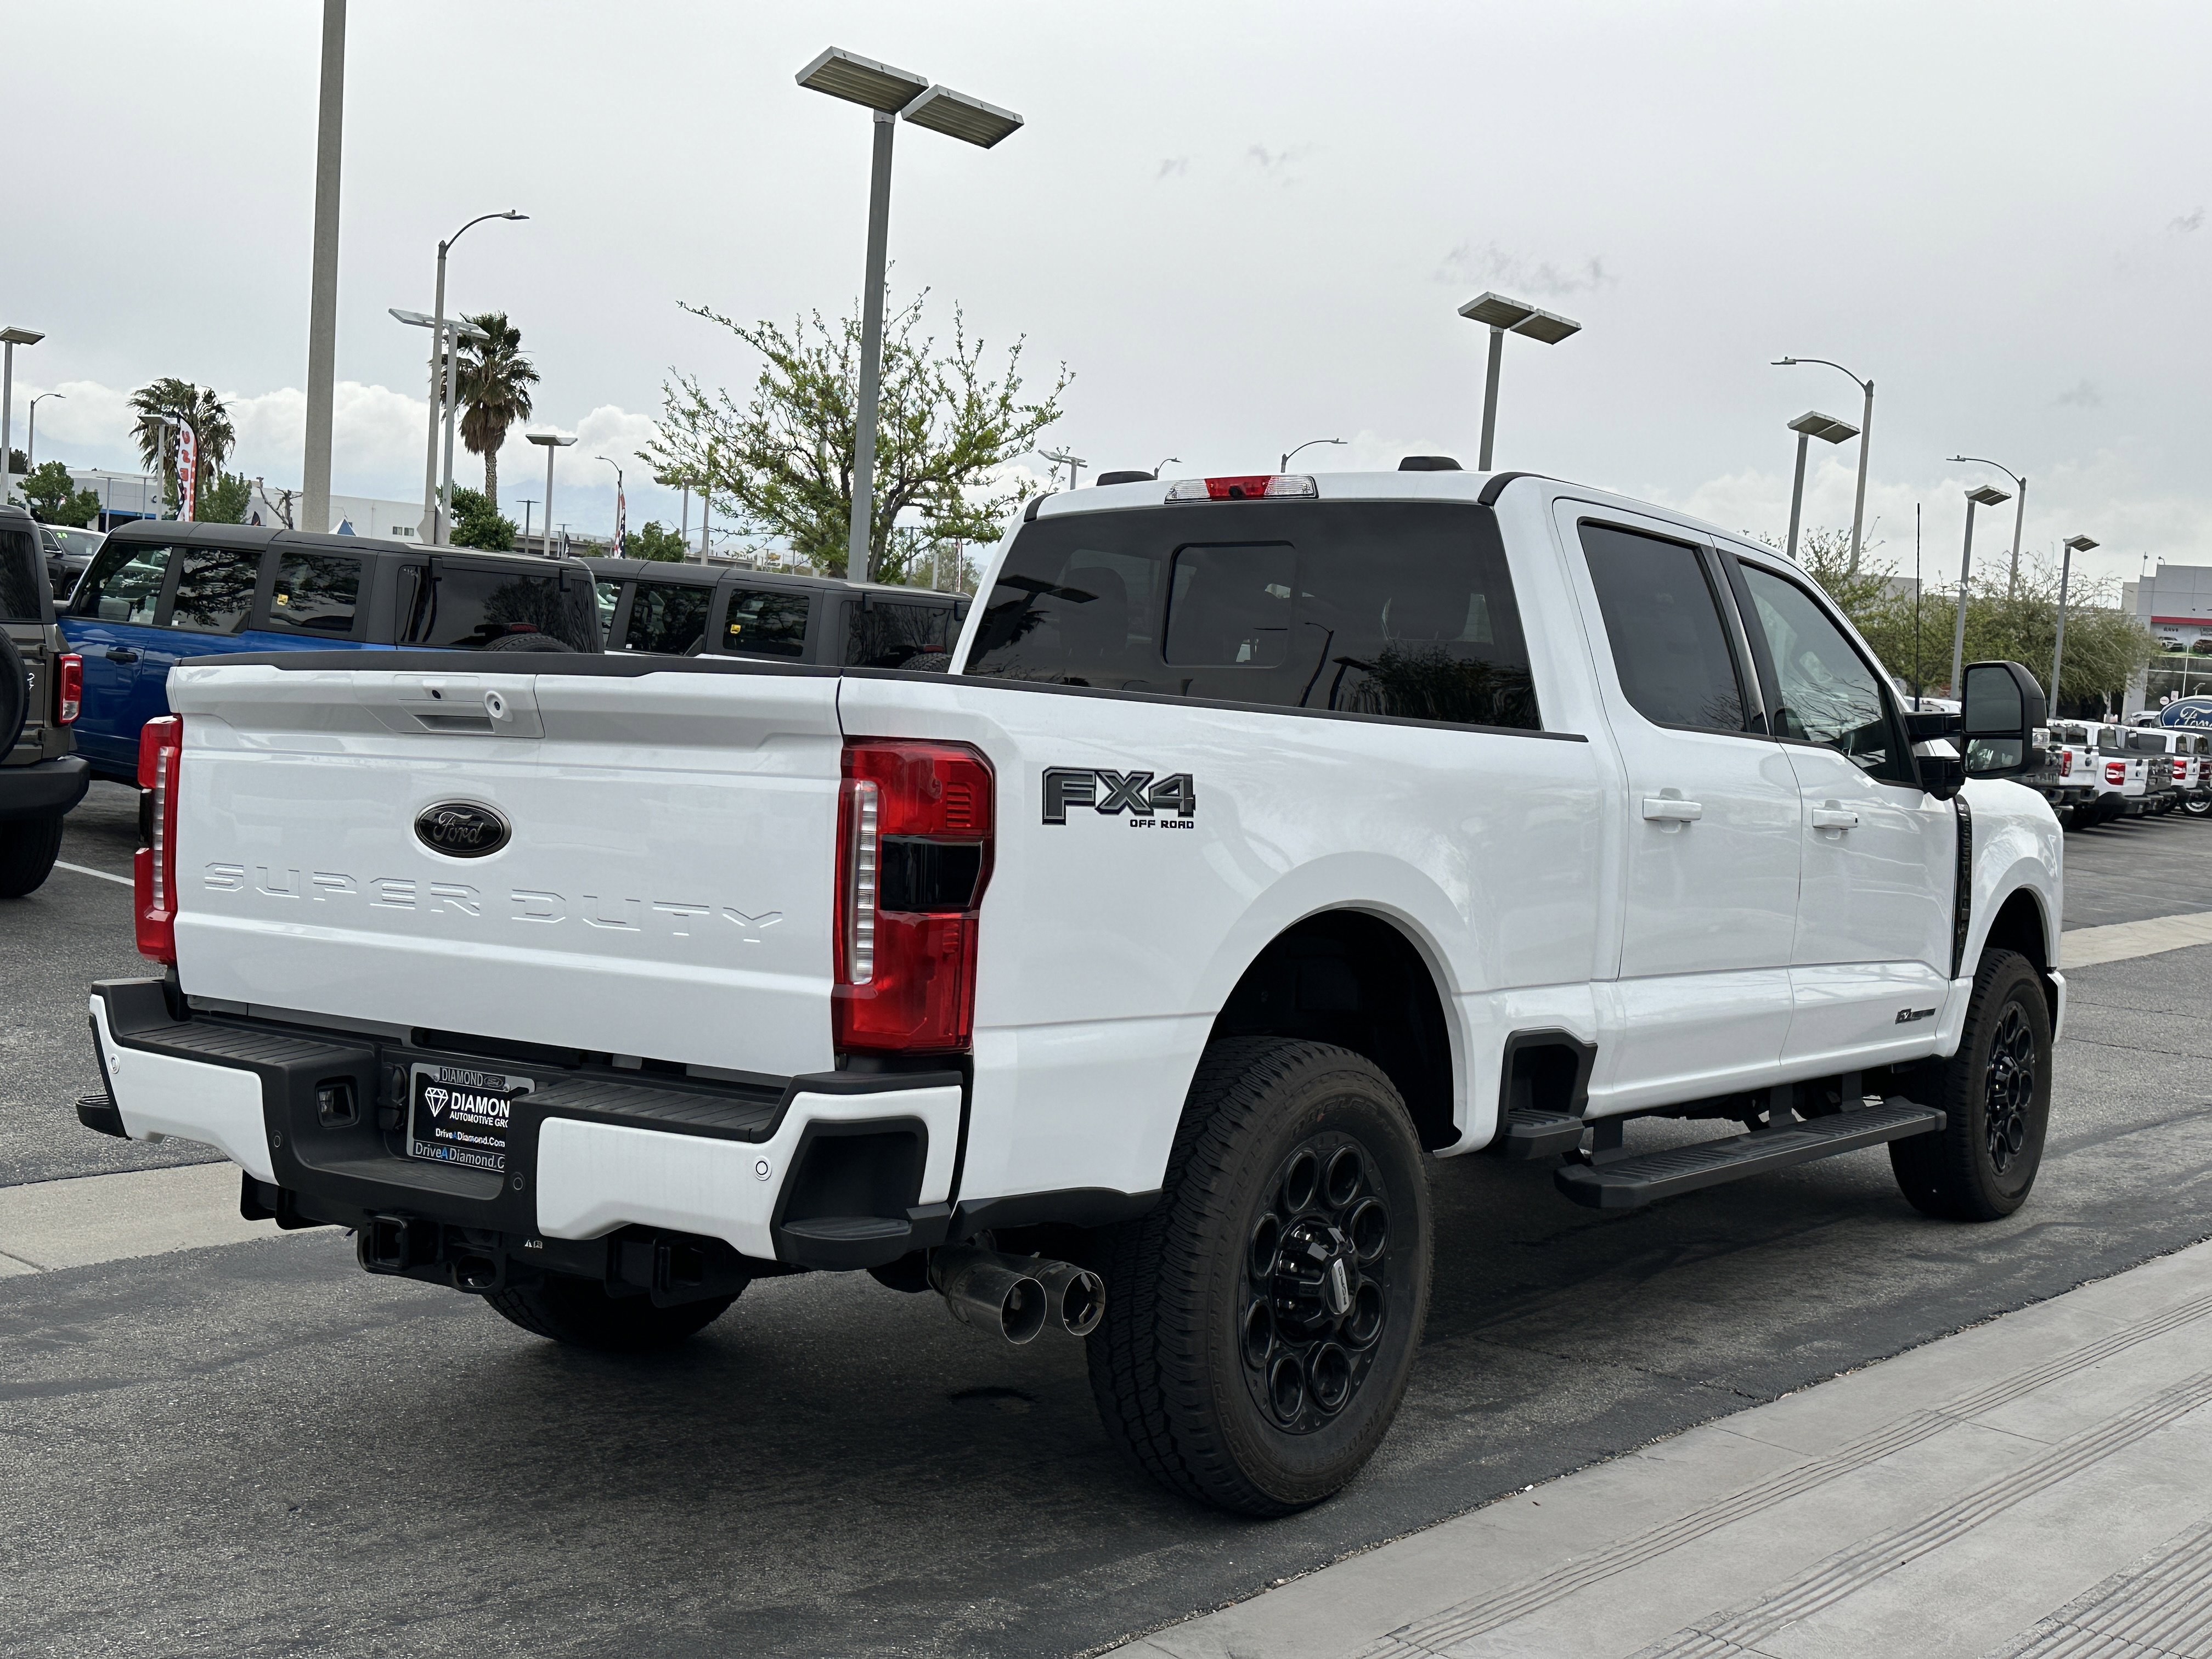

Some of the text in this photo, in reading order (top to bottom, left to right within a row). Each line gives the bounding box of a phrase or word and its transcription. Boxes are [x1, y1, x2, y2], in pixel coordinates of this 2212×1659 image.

[1042, 766, 1196, 826] FX4
[433, 811, 484, 843] Ford
[1130, 819, 1194, 829] OFF ROAD
[204, 862, 783, 943] SUPER DUTY
[442, 1068, 483, 1086] DIAMOND
[450, 1092, 510, 1118] DIAMON
[449, 1111, 494, 1126] AUTOMOTIVE
[415, 1142, 505, 1169] DriveADiamond.C
